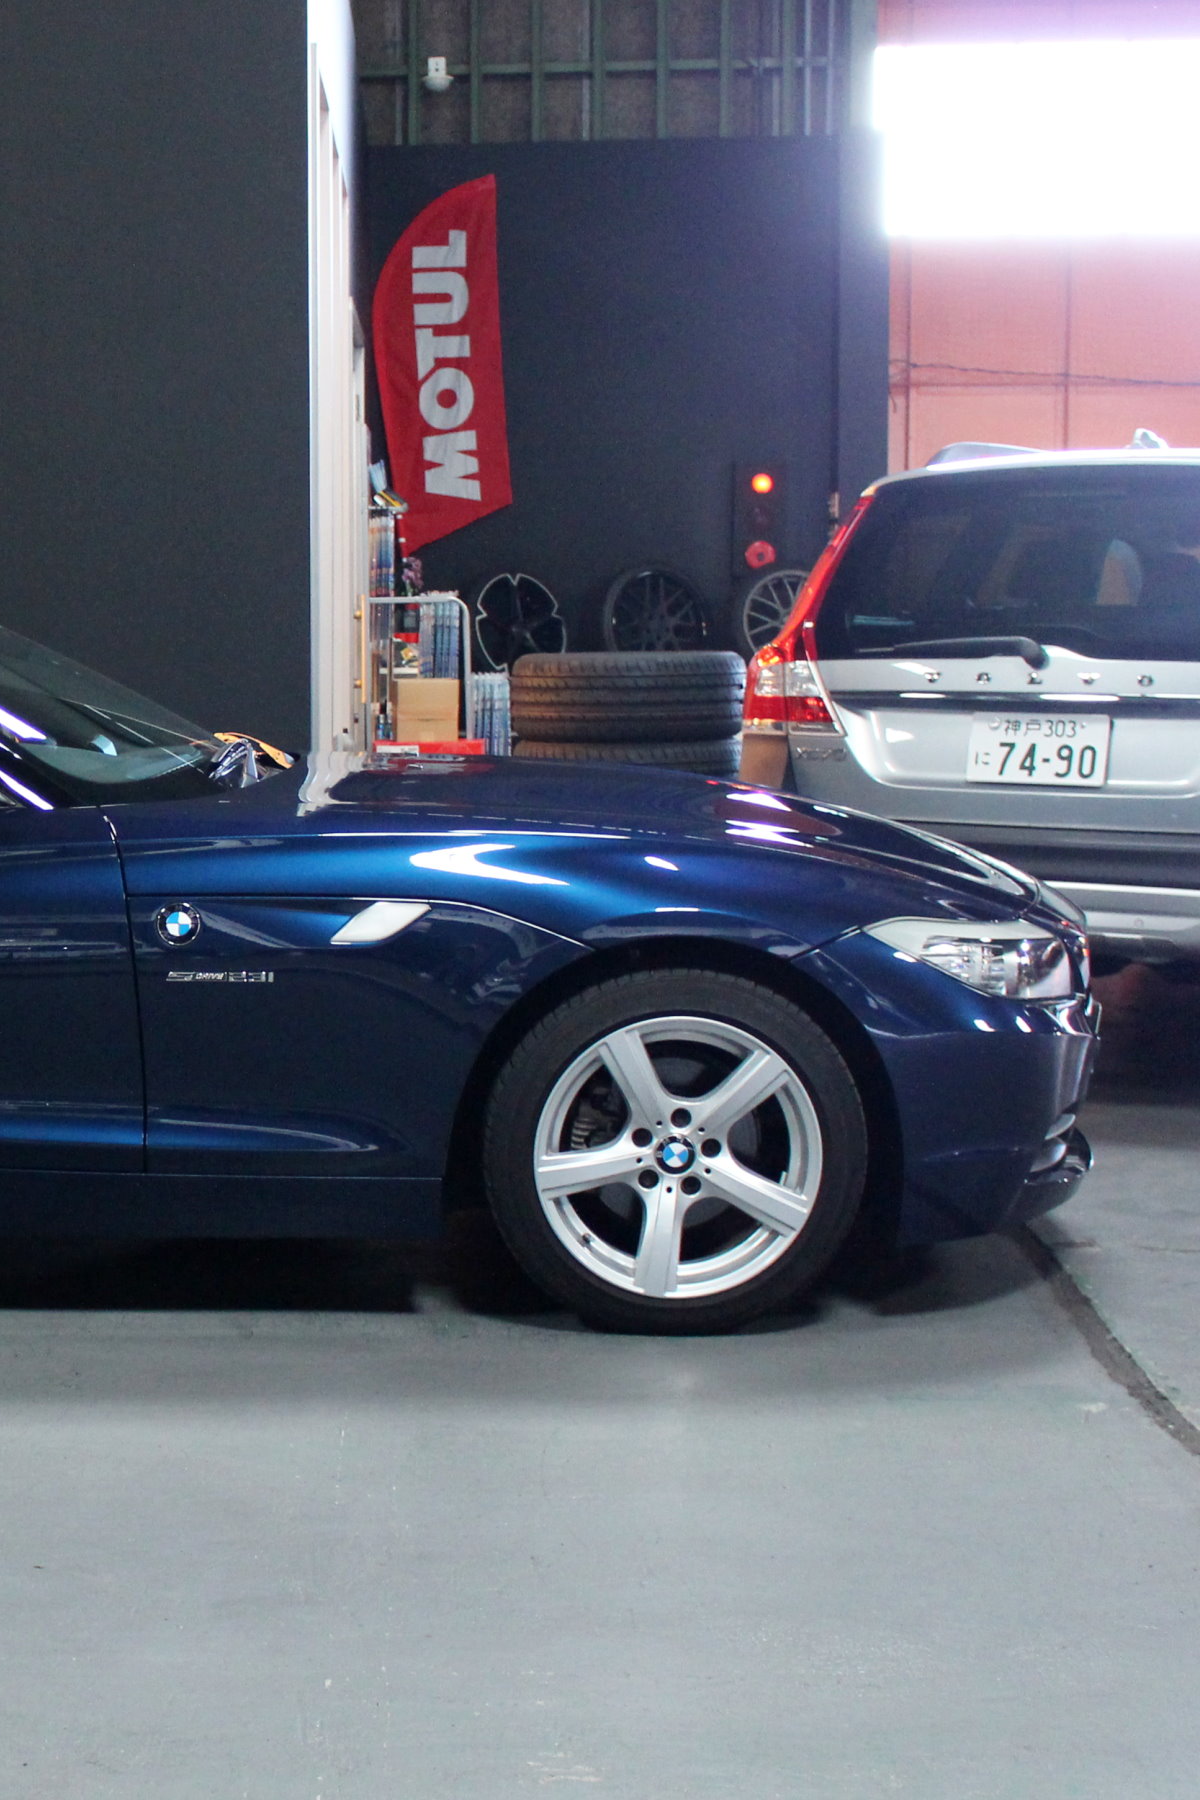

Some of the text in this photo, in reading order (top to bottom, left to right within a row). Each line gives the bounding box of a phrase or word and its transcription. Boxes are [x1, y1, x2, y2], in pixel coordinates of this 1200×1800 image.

[411, 229, 482, 501] MOTUL
[923, 670, 1155, 688] VOLVO
[998, 742, 1097, 779] 74-90
